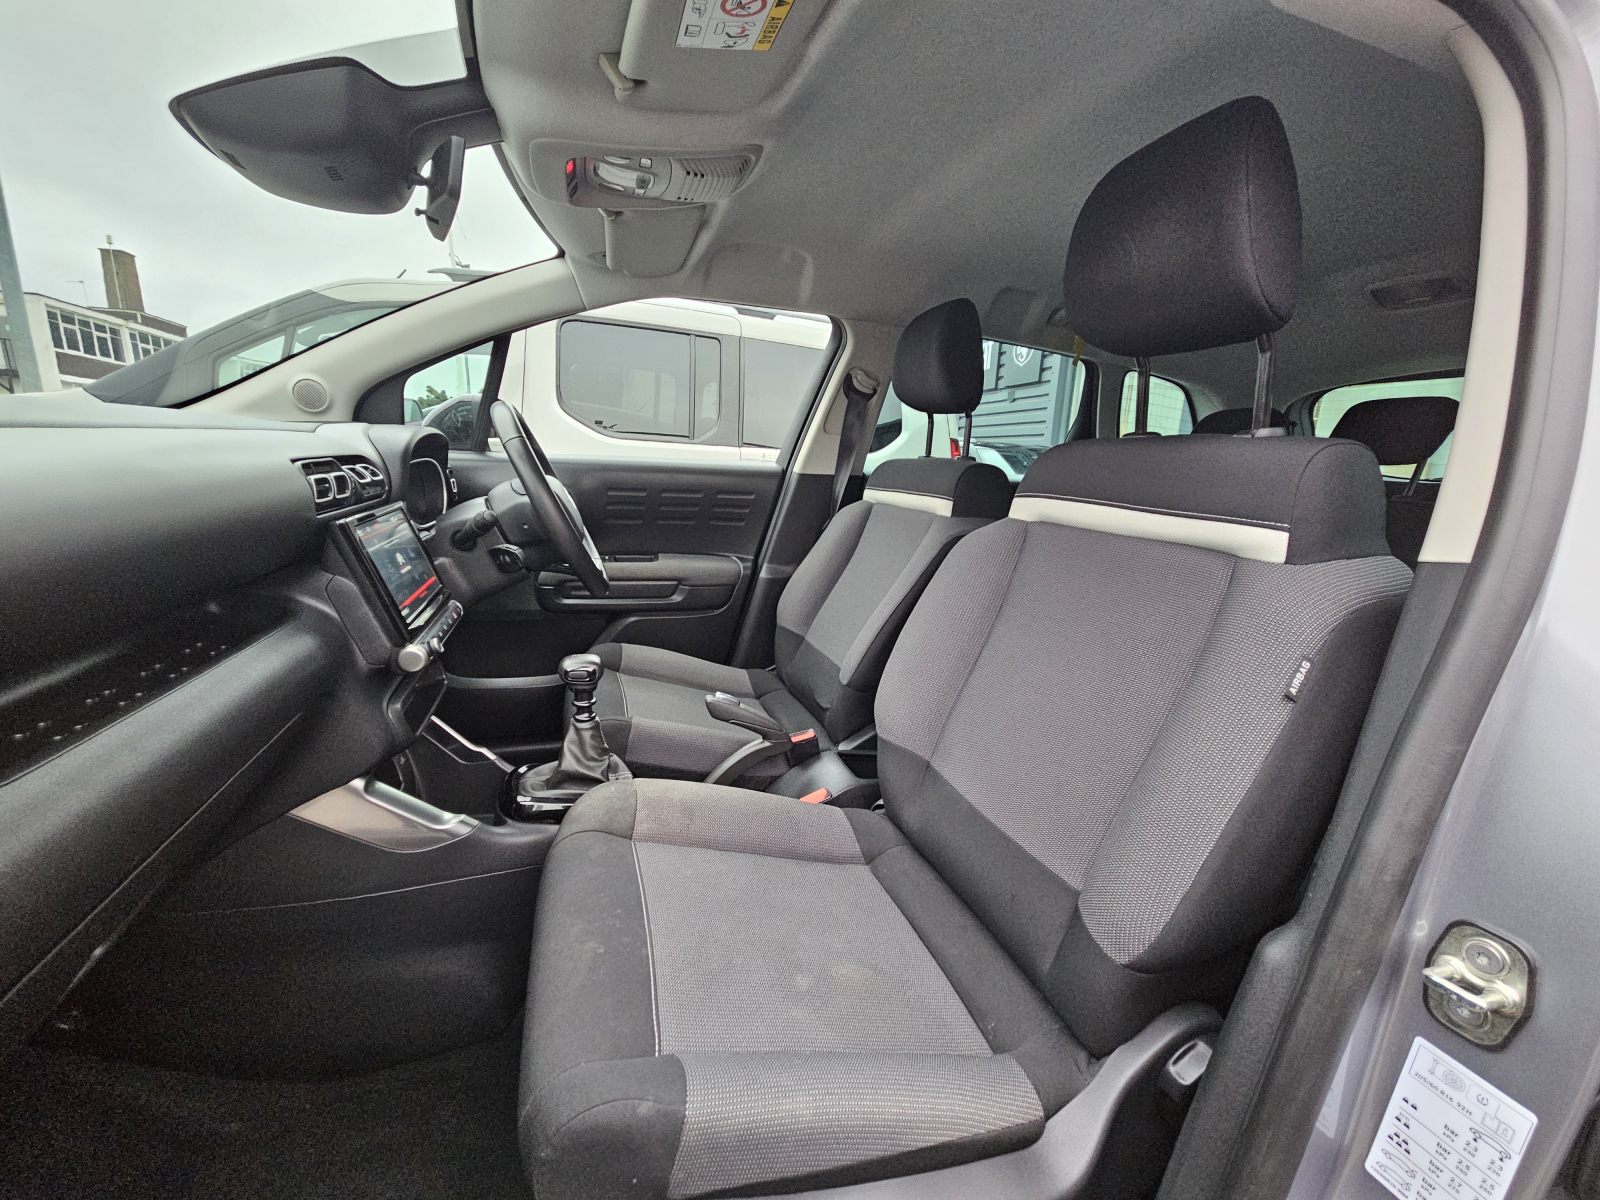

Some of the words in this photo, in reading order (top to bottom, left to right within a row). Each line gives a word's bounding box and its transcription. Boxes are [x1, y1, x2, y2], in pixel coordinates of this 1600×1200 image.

[758, 17, 783, 44] AIRBAG
[1289, 660, 1311, 696] AIRBAG
[1414, 1071, 1439, 1091] 205/60
[1440, 1090, 1454, 1103] R16
[1457, 1102, 1473, 1116] 92H
[1442, 1131, 1455, 1143] kPa
[1462, 1146, 1476, 1158] 230
[1487, 1165, 1501, 1177] 230
[1444, 1123, 1459, 1138] bar
[1465, 1140, 1478, 1153] 2.3
[1489, 1159, 1503, 1172] 2.3
[1428, 1167, 1440, 1178] kPa
[1447, 1182, 1460, 1194] 270
[1429, 1159, 1444, 1173] bar
[1449, 1176, 1462, 1188] 2.7
[1435, 1149, 1447, 1161] kPa
[1455, 1165, 1468, 1176] 250
[1479, 1183, 1492, 1196] 250
[1437, 1141, 1451, 1155] bar
[1457, 1158, 1470, 1171] 2.5
[1481, 1177, 1495, 1191] 2.5
[1416, 1190, 1428, 1200] ba
[1421, 1184, 1432, 1196] kPa
[1422, 1177, 1437, 1191] bar
